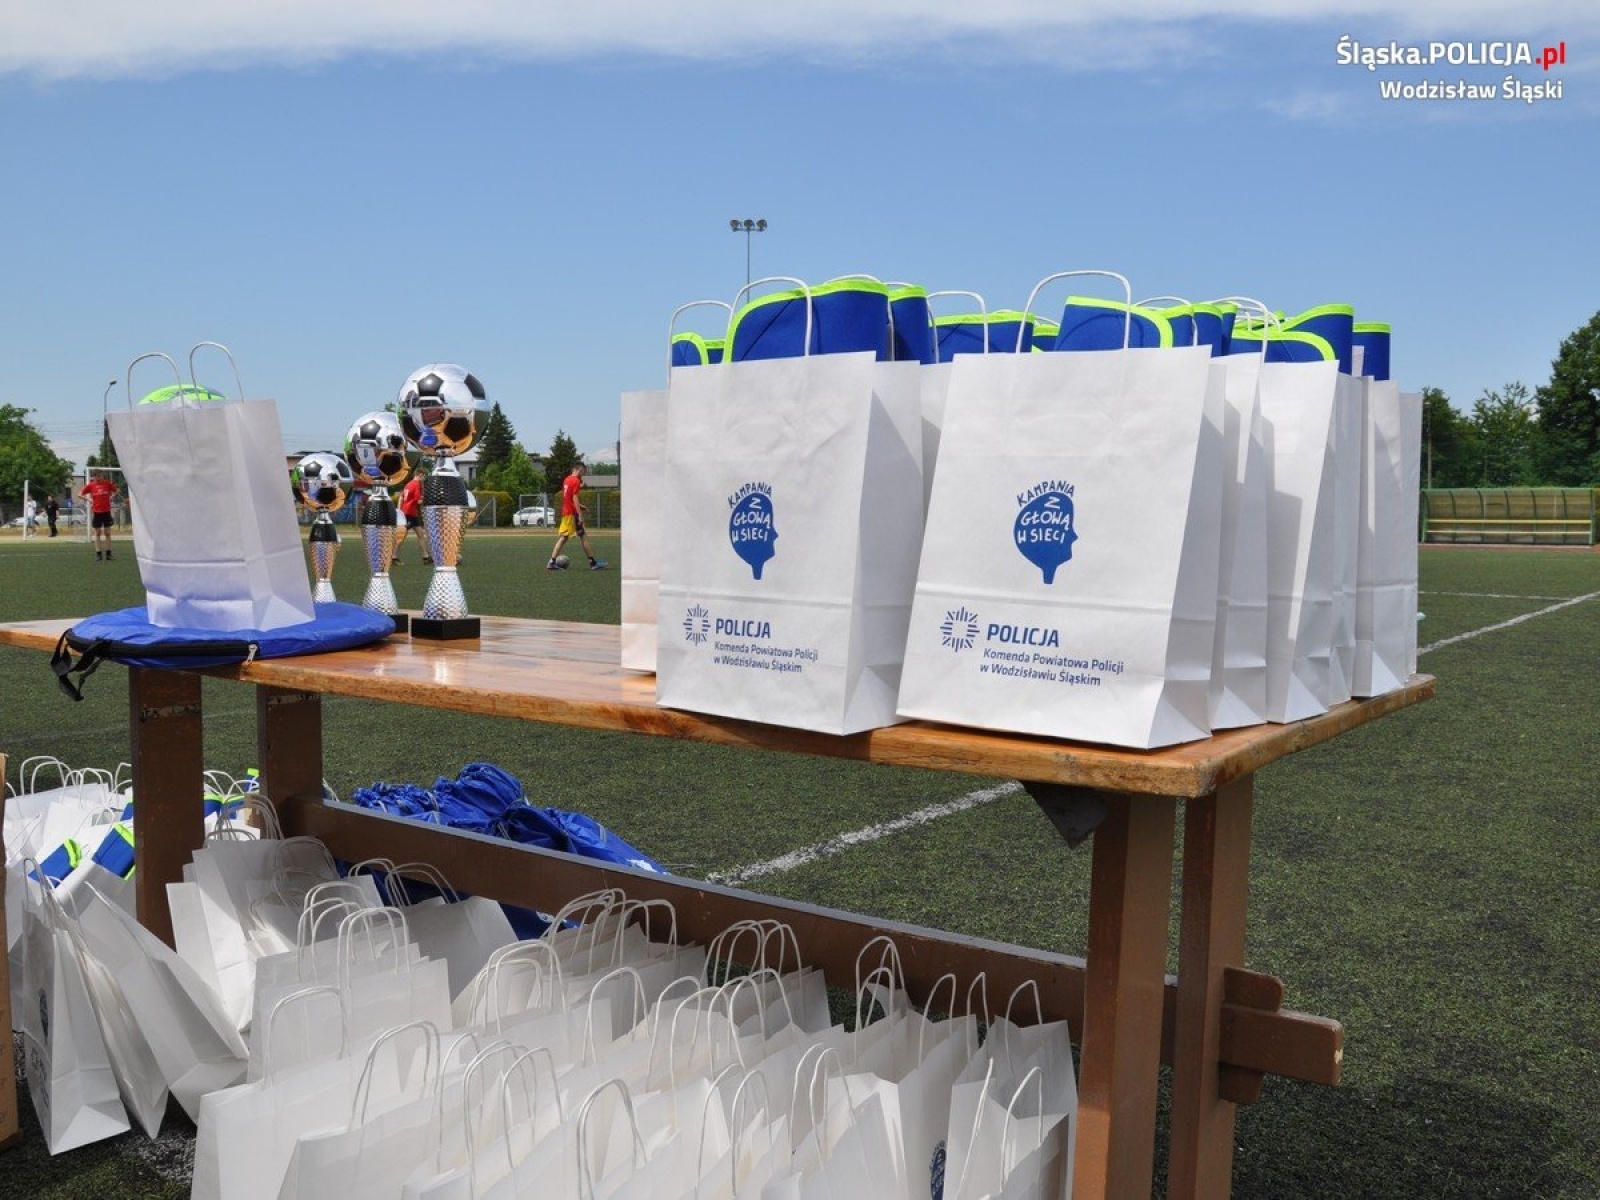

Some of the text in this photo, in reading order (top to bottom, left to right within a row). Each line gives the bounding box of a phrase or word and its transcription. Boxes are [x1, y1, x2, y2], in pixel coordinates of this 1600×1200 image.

[727, 482, 773, 509] KAMPANIA
[749, 497, 763, 510] Z
[1016, 480, 1076, 508] KAMPANIA
[1044, 495, 1061, 510] Z
[732, 511, 771, 529] GŁOWĄ
[1020, 511, 1071, 530] GŁOWĄ
[740, 527, 769, 543] SIECI
[1030, 528, 1066, 544] SIECI
[715, 617, 772, 639] POLICJA
[986, 623, 1060, 648] POLICJA
[714, 640, 819, 662] Komenda Powiatowa Policji
[713, 654, 802, 675] w Wodzisławiu Śląskim
[983, 648, 1124, 676] Komenda Powiatowa Policji
[979, 663, 1101, 687] w Wodzisławiu Śląskim
